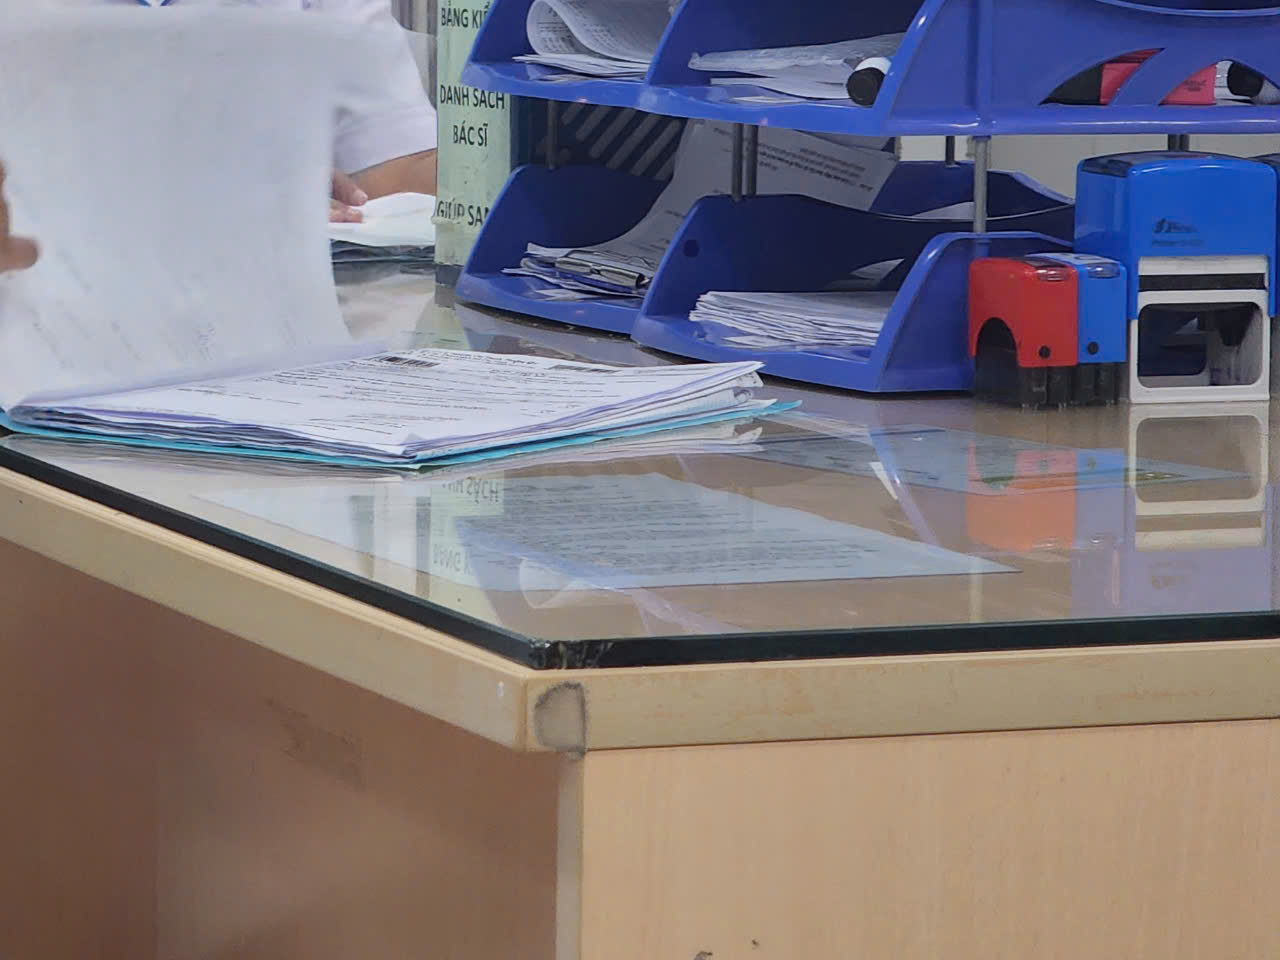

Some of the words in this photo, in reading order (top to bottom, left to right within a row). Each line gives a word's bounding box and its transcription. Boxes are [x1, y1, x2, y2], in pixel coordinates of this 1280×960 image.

[441, 0, 469, 28] BẢNG
[440, 84, 469, 107] DANH
[453, 120, 475, 147] BÁC
[477, 123, 489, 148] SĨ
